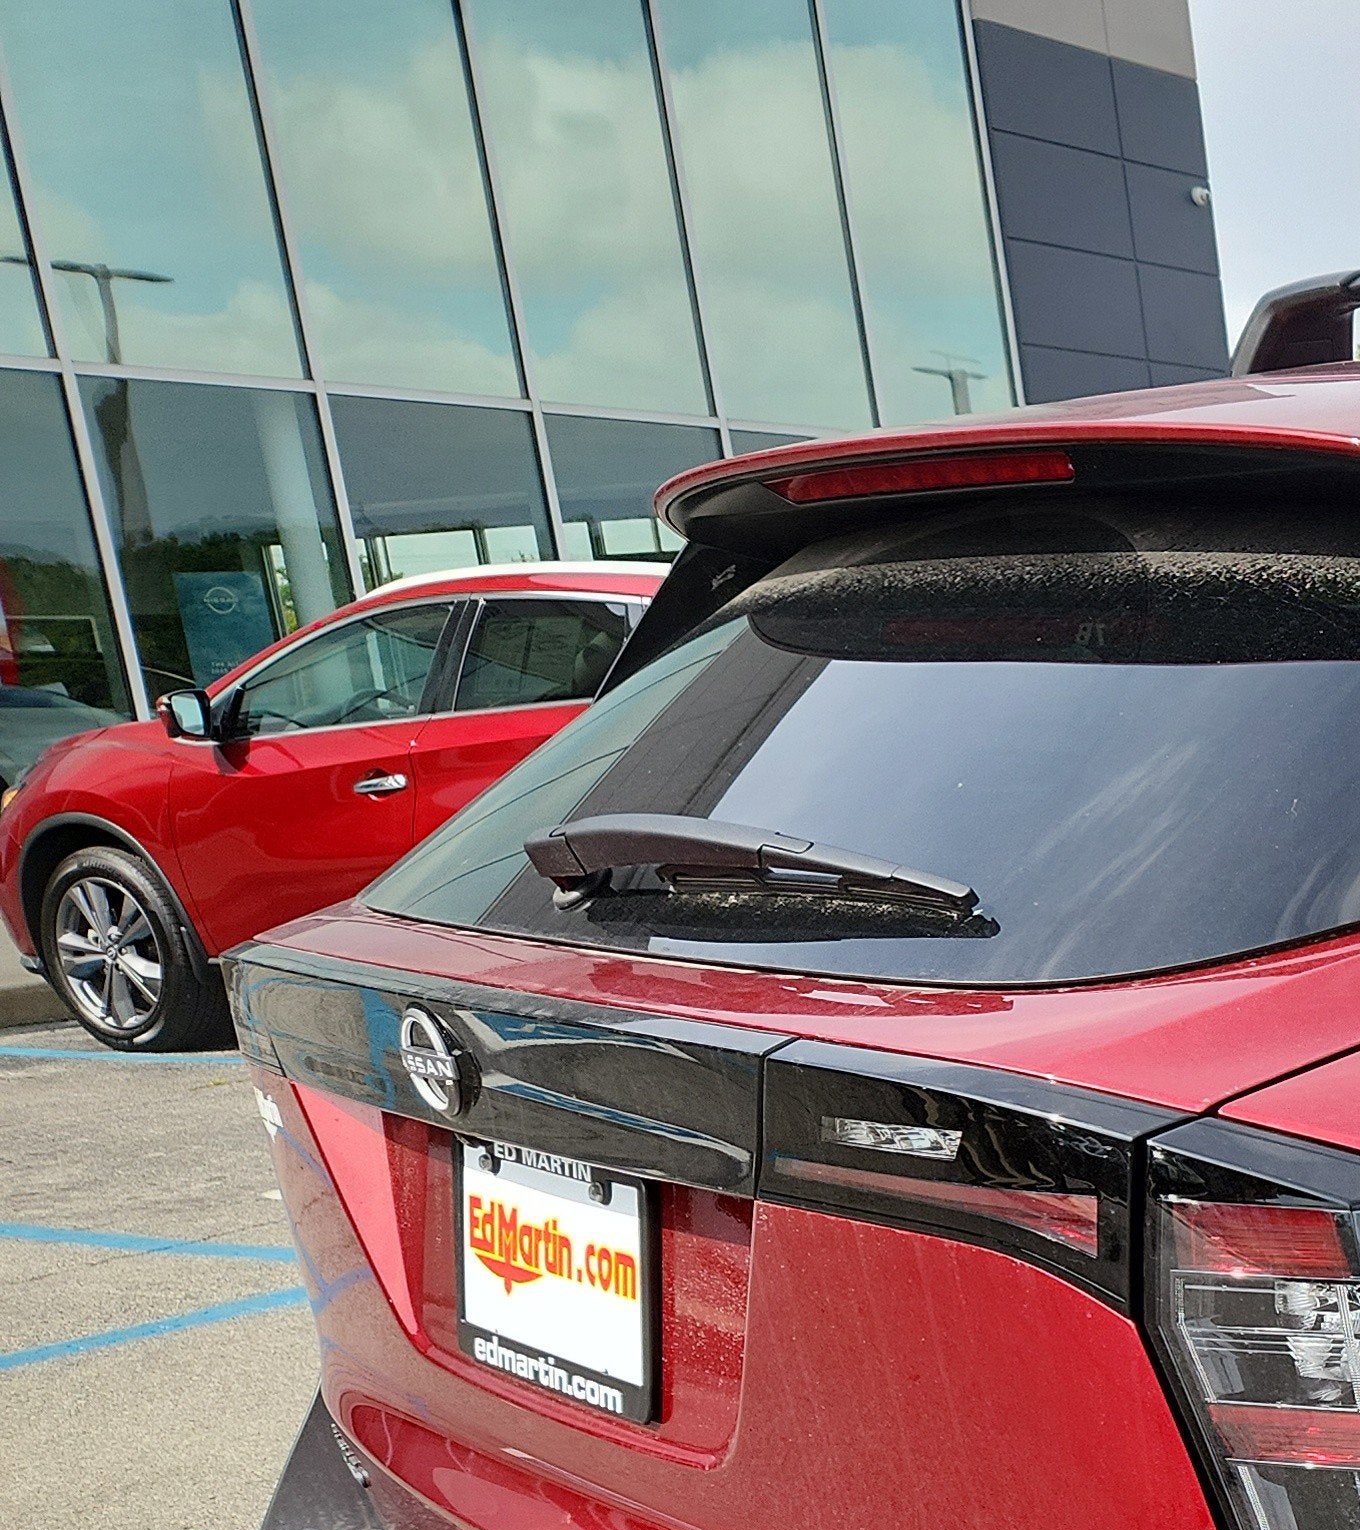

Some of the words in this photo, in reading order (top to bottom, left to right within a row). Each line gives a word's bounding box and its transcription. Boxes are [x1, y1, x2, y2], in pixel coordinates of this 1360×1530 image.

[494, 1142, 516, 1160] ED
[521, 1149, 592, 1183] MARTIN
[469, 1193, 637, 1301] EdMartin.com
[474, 1336, 624, 1414] edmartin.com
